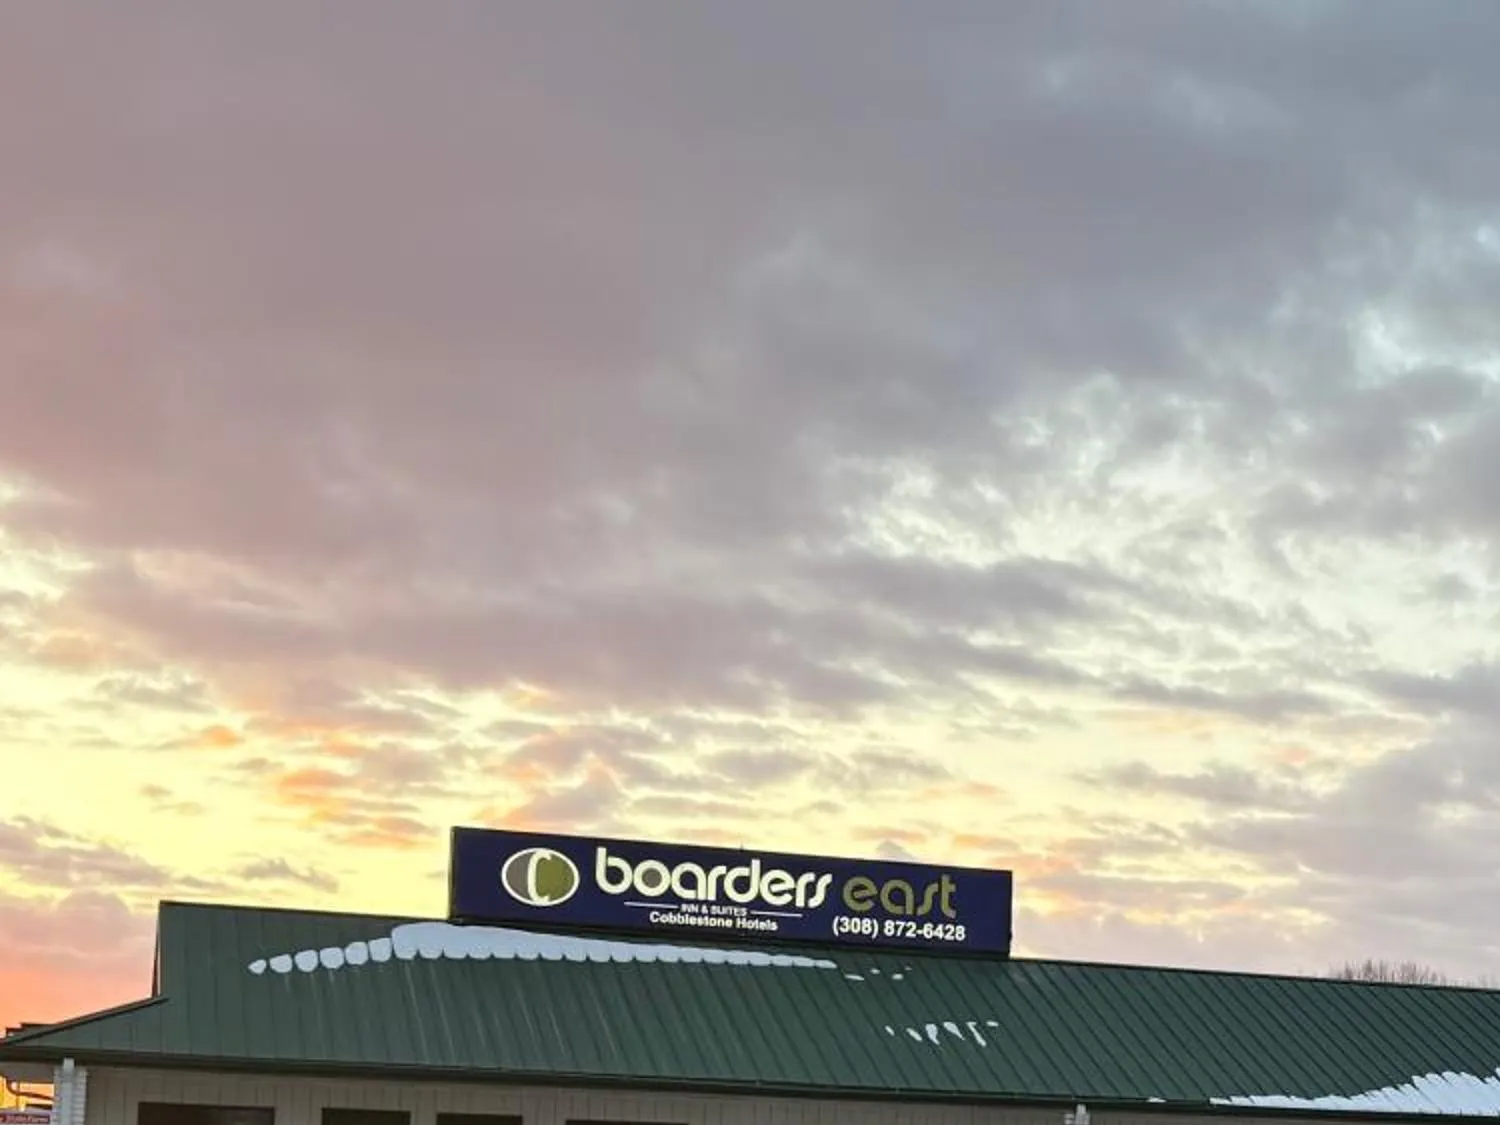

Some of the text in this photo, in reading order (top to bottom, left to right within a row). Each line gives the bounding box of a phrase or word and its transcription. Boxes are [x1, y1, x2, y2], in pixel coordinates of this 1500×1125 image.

[596, 847, 957, 919] boarders east
[649, 910, 779, 932] Cobblestone Hotels
[681, 903, 748, 917] INN & SUITES
[832, 916, 966, 942] (308) 872-6428
